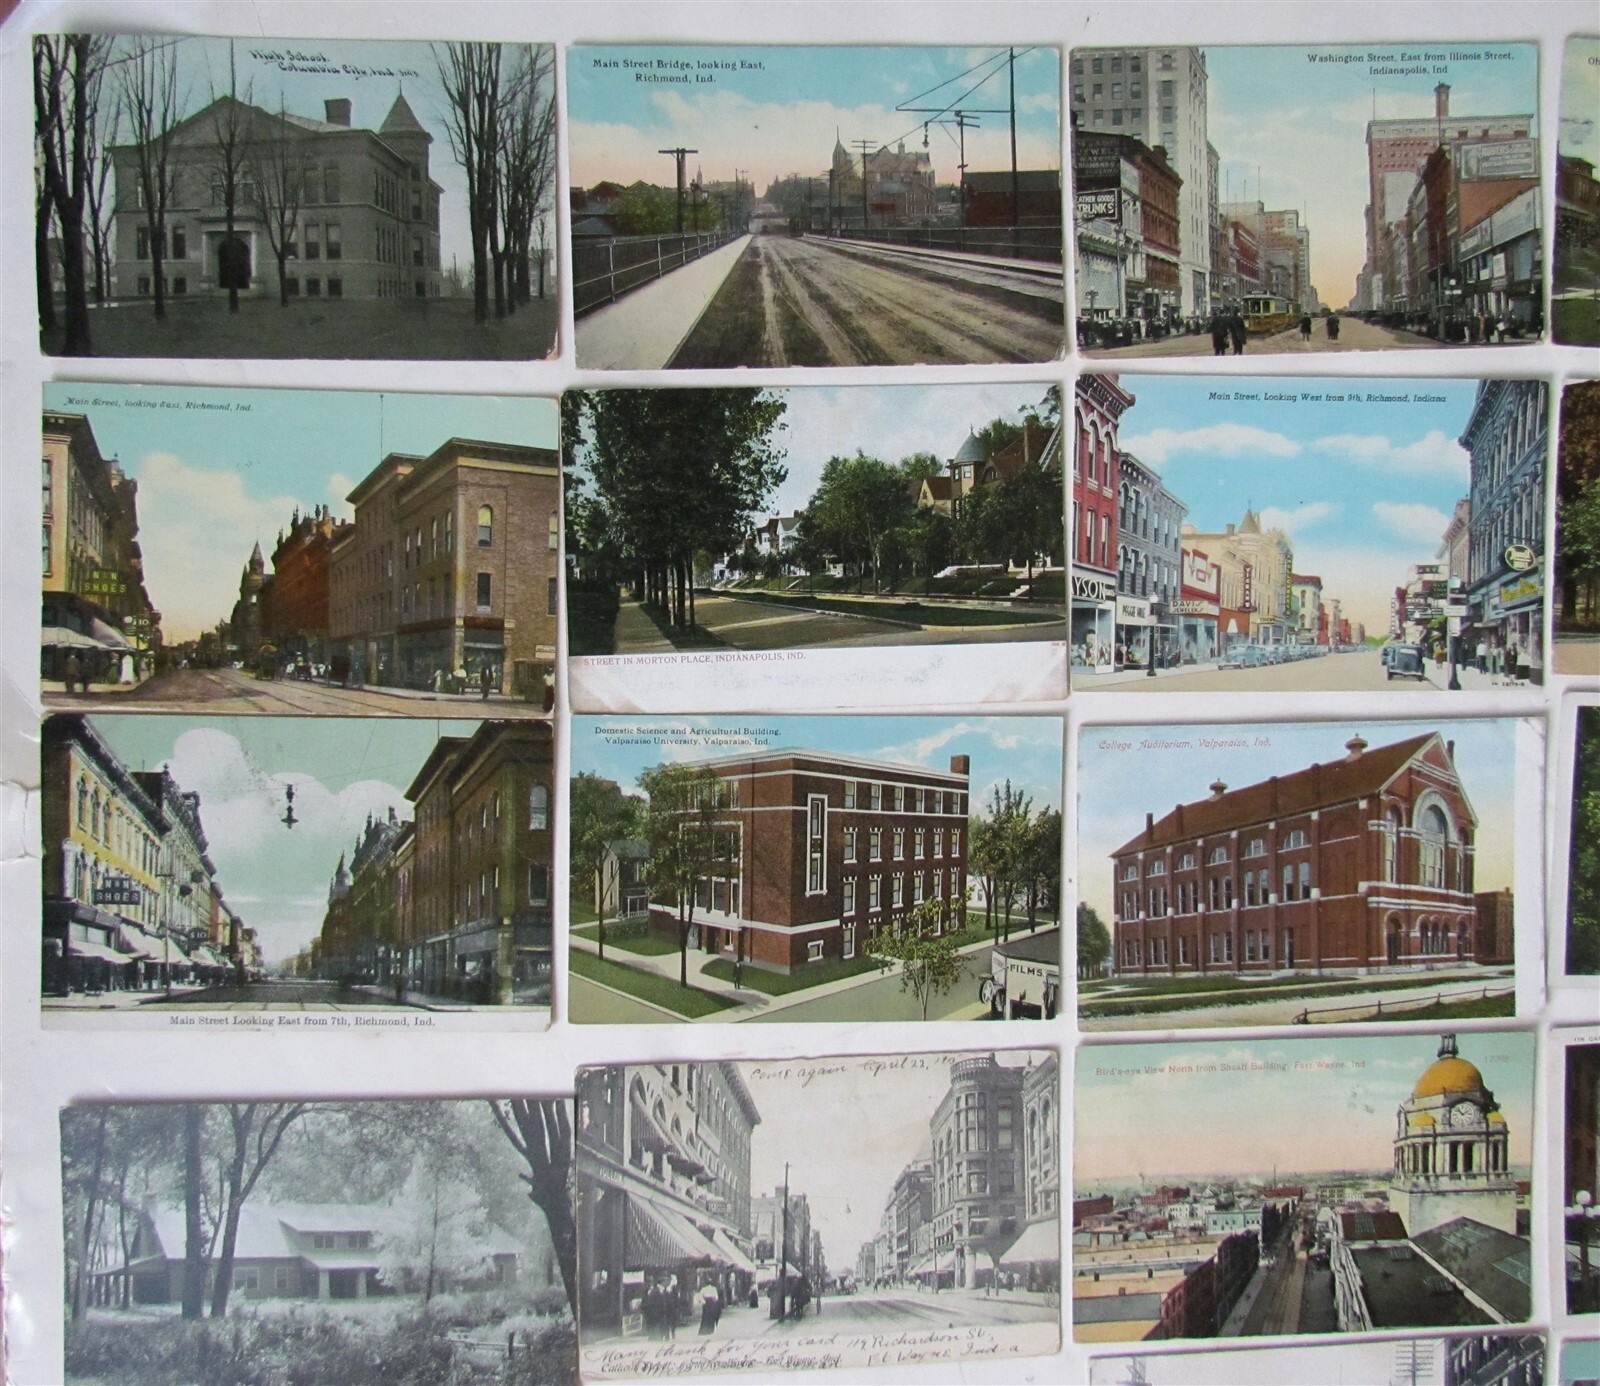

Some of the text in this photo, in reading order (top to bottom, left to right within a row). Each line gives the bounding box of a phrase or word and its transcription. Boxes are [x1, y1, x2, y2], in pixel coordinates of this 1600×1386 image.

[249, 50, 285, 65] High
[1307, 53, 1364, 64] Washington
[1400, 53, 1421, 62] East
[1424, 53, 1446, 62] from
[1449, 51, 1482, 61] Illinois
[278, 62, 341, 75] Columbia
[592, 59, 766, 71] Main Street Bridge, looking East,
[1369, 65, 1430, 76] Indianapolis,
[635, 73, 716, 84] Richmond, Ind.
[1077, 203, 1114, 214] TRUNKS
[1208, 392, 1231, 401] Main
[1233, 392, 1260, 402] Street,
[1263, 392, 1297, 402] Looking
[1300, 393, 1322, 401] West
[1325, 393, 1345, 402] from
[1366, 393, 1410, 403] Richmond,
[1413, 394, 1447, 403] Indiana
[64, 397, 89, 406] Main
[91, 398, 121, 408] Street,
[125, 399, 157, 409] looking
[185, 401, 233, 412] Richmond,
[235, 402, 254, 412] Ind.
[84, 582, 127, 593] SHOES
[584, 651, 806, 666] STREET IN MORTON PLACE, INDIANAPOLIS, IND.
[595, 727, 634, 735] Domestic
[636, 727, 668, 735] Science
[670, 727, 687, 735] and
[689, 727, 741, 736] Agricultural
[605, 737, 651, 746] Valparaiso
[754, 737, 771, 746] Ind.
[1099, 739, 1132, 751] College
[96, 892, 138, 902] SHOES
[170, 1015, 436, 1028] Main Street Looking East from 7th, Richmond, Ind.
[1144, 1066, 1165, 1074] View
[1168, 1064, 1193, 1073] North
[1196, 1064, 1217, 1073] from
